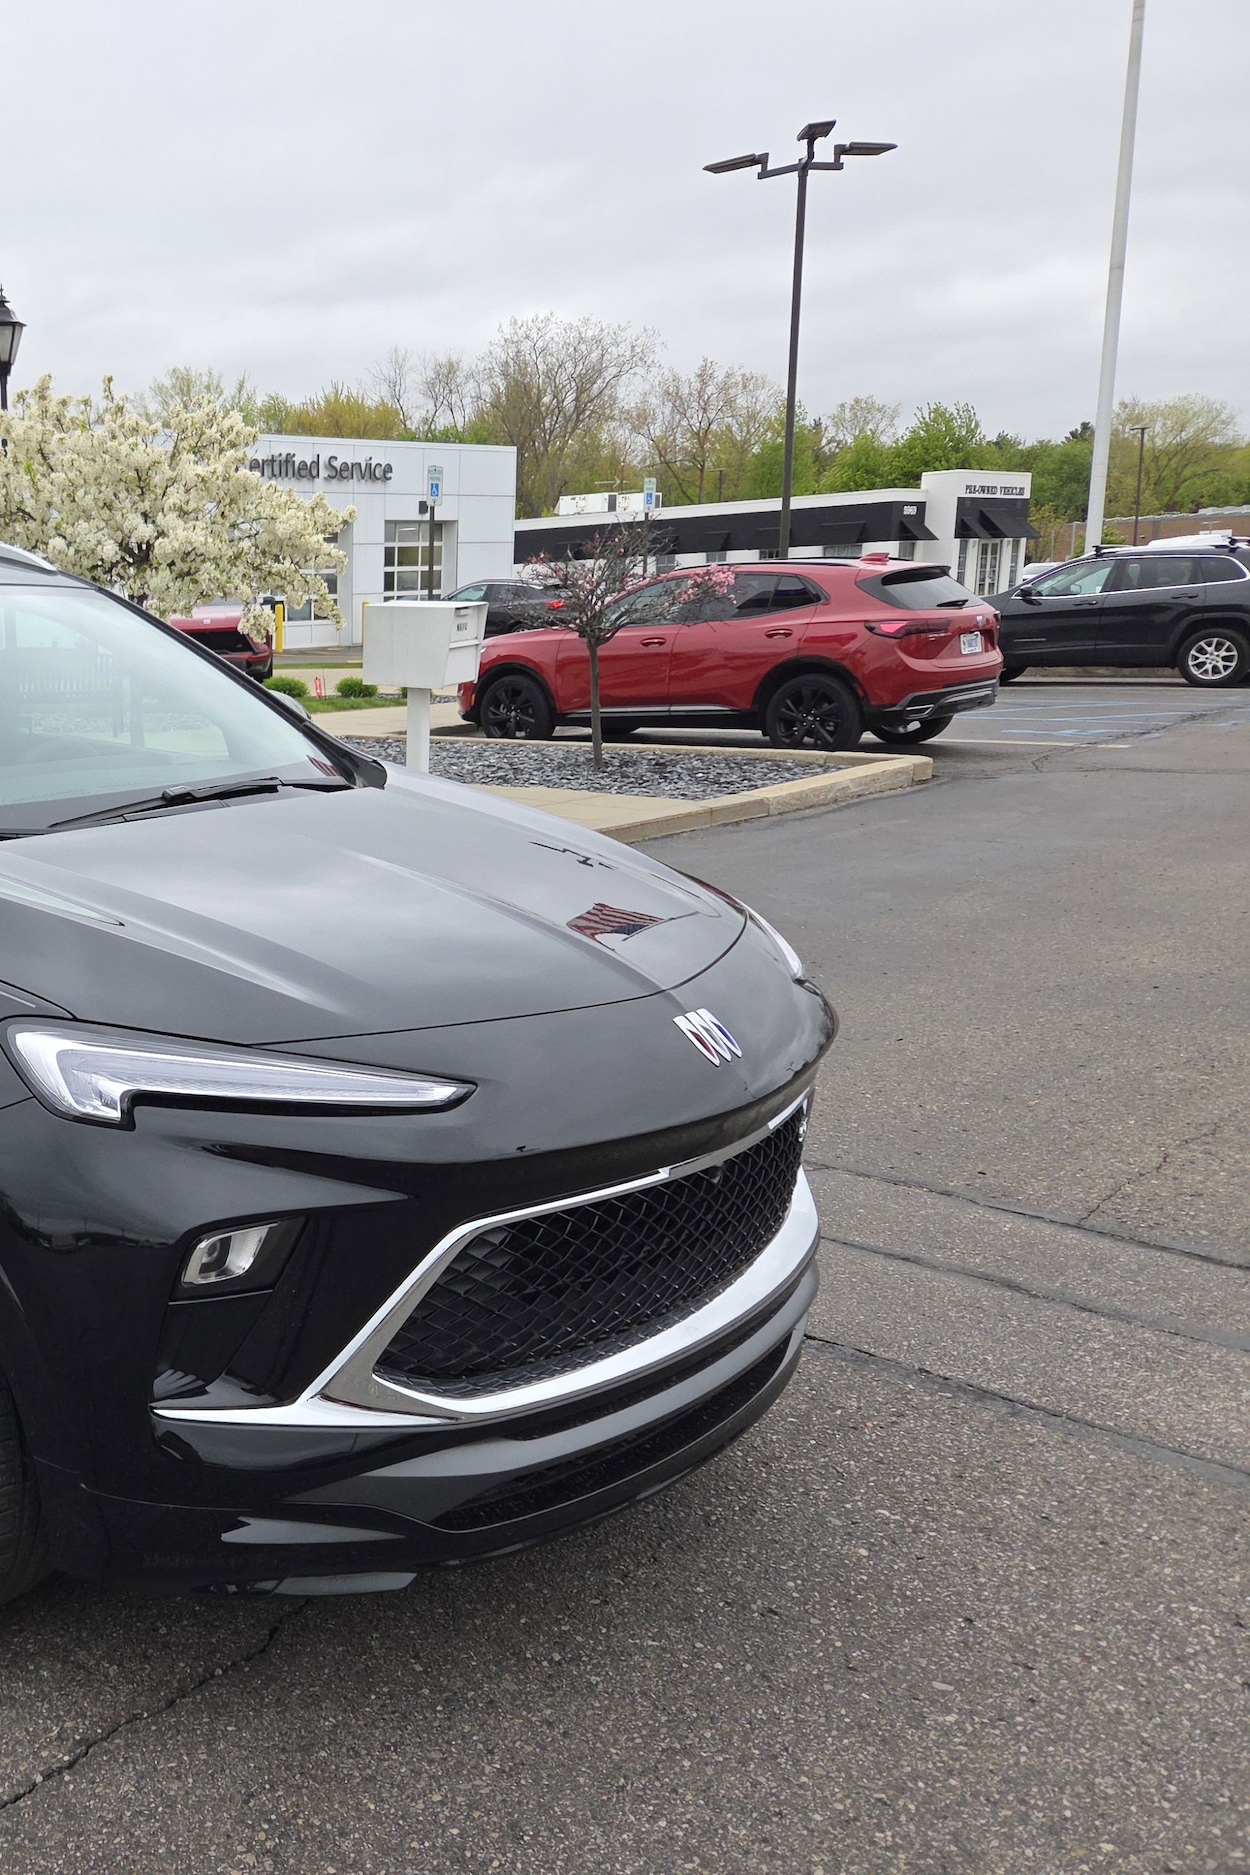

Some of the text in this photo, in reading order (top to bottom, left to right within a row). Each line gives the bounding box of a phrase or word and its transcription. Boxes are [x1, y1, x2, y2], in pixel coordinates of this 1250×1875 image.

[248, 453, 393, 481] ertified Service
[965, 485, 1026, 496] PRE-OWNED VEHICLES
